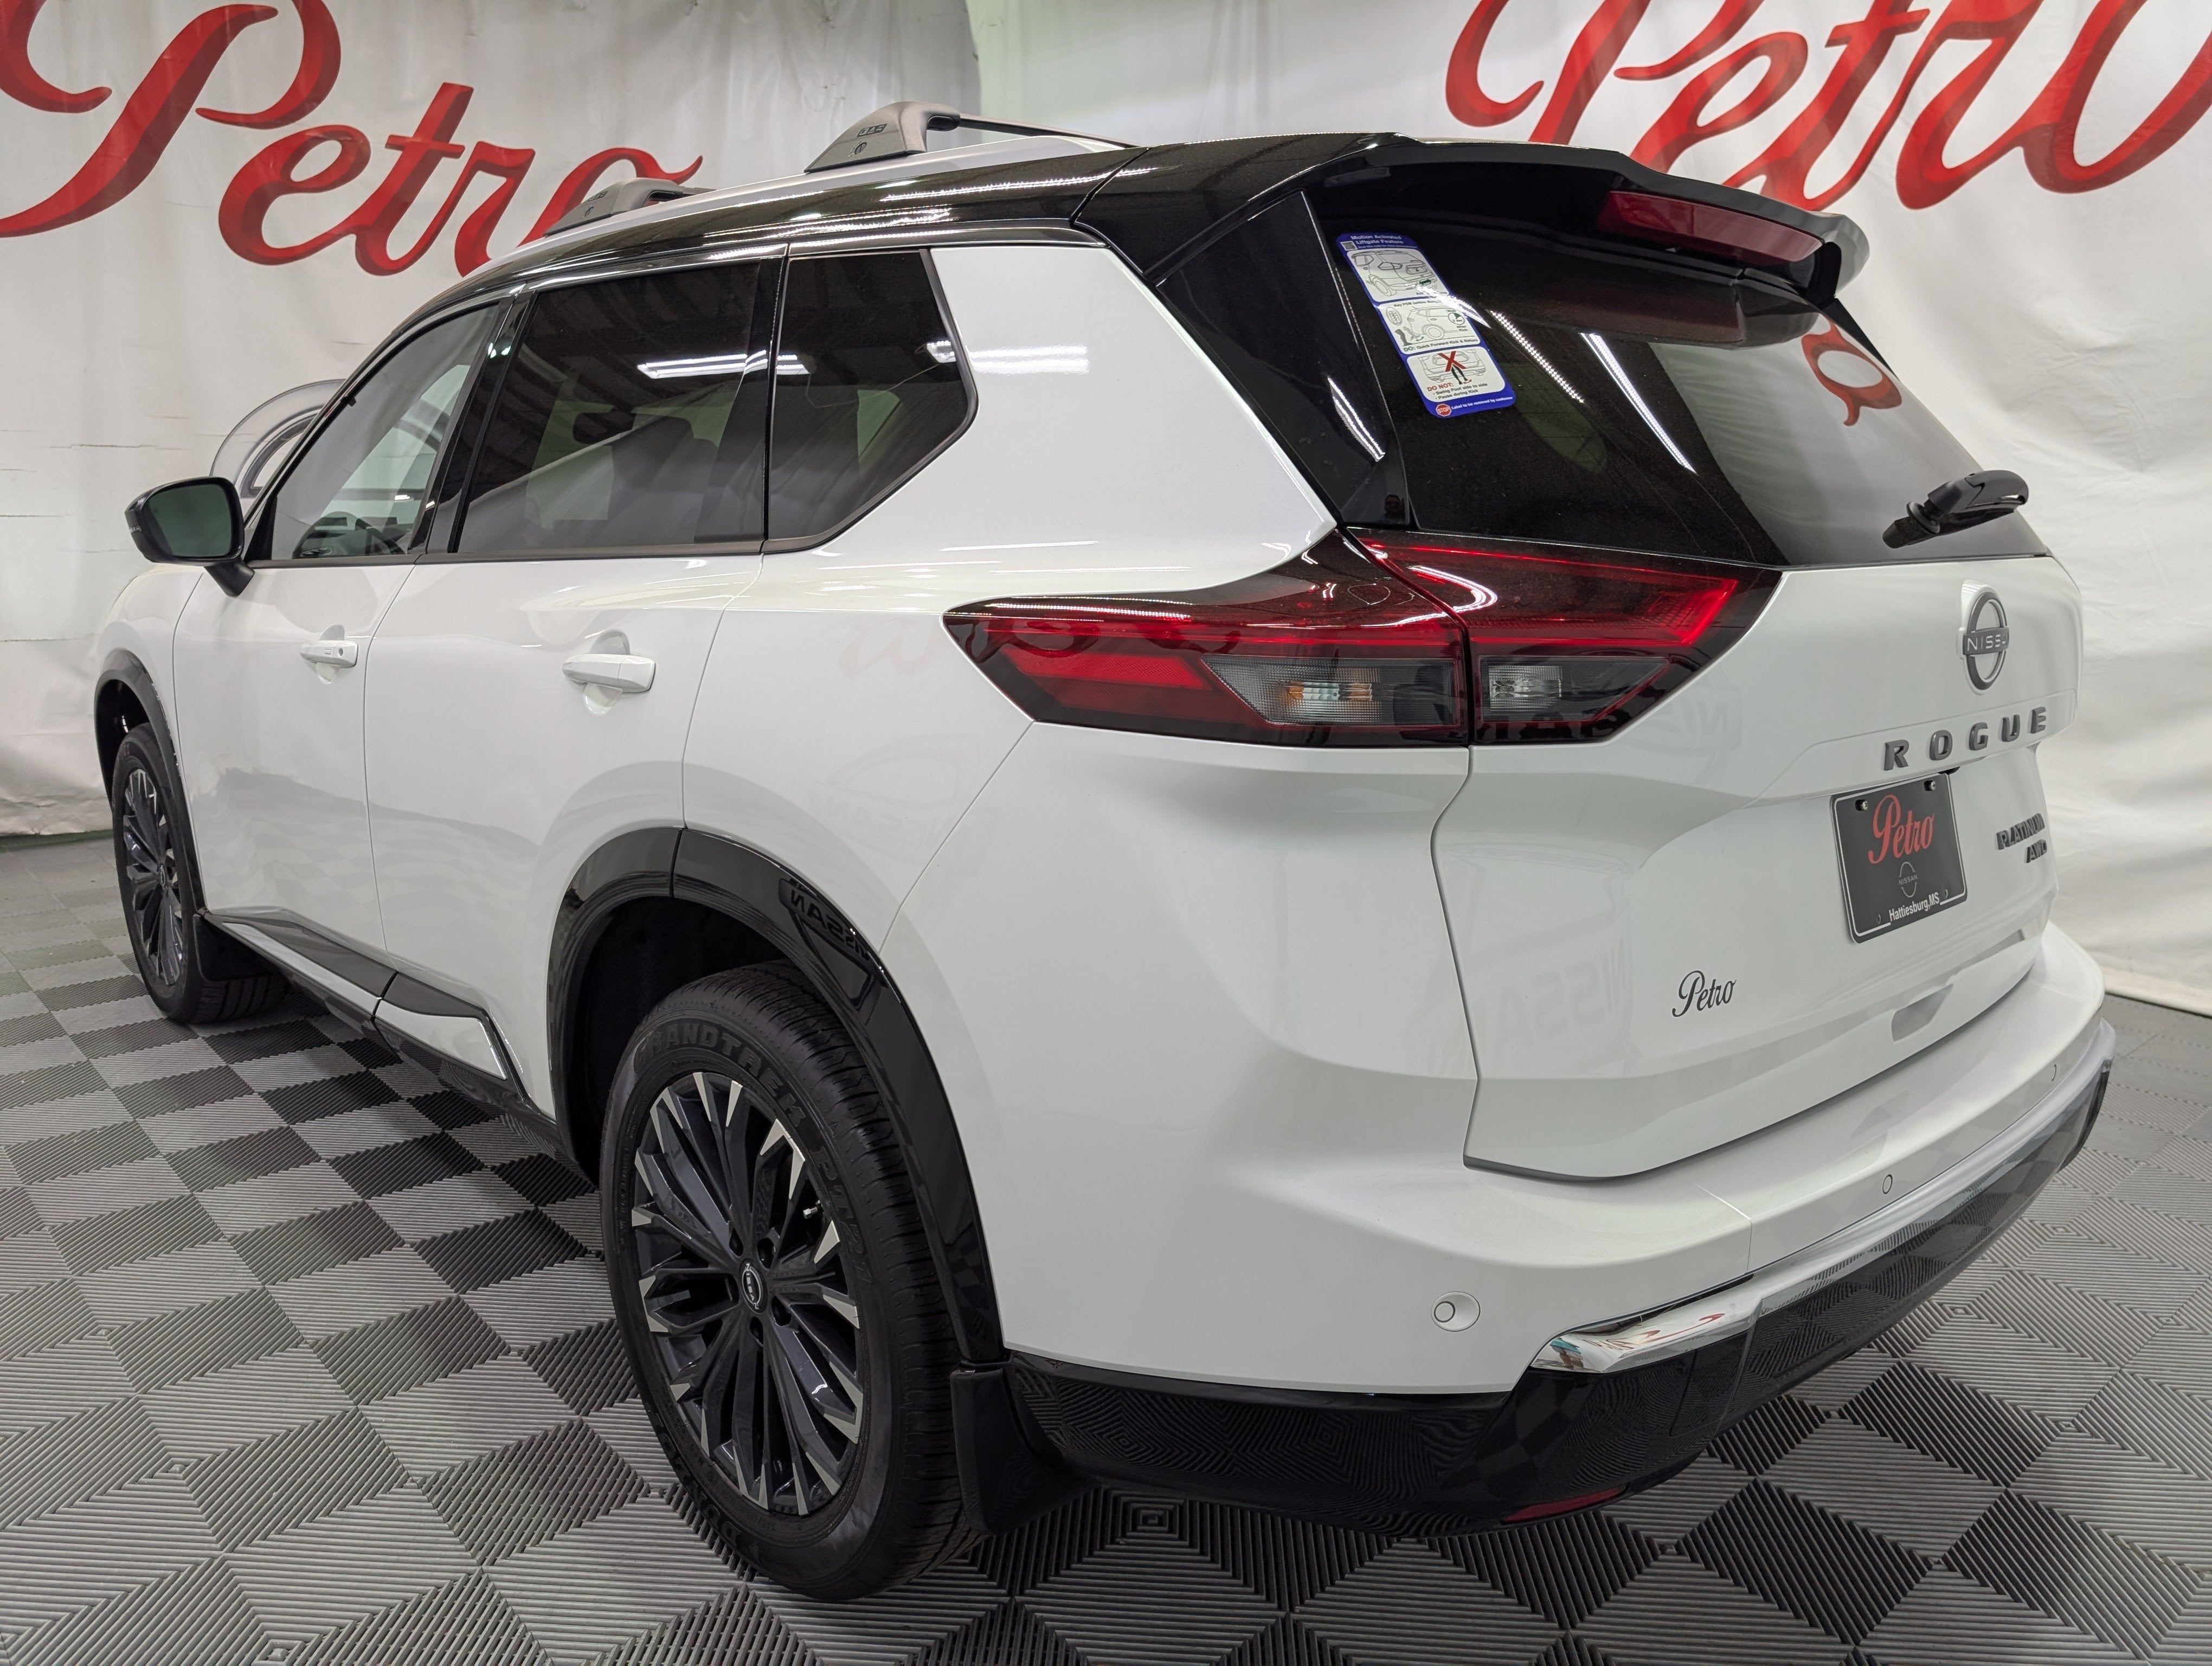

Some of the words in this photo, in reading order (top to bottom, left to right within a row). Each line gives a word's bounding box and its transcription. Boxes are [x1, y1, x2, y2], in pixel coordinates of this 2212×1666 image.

[1883, 706, 2047, 771] ROGUE
[1867, 793, 1935, 864] Petro
[1996, 813, 2046, 850] PLATINUM
[2025, 839, 2048, 863] AWD
[1898, 874, 1918, 885] NISSAN
[1672, 970, 1737, 1017] Petro
[634, 1022, 807, 1127] GRANDTREK
